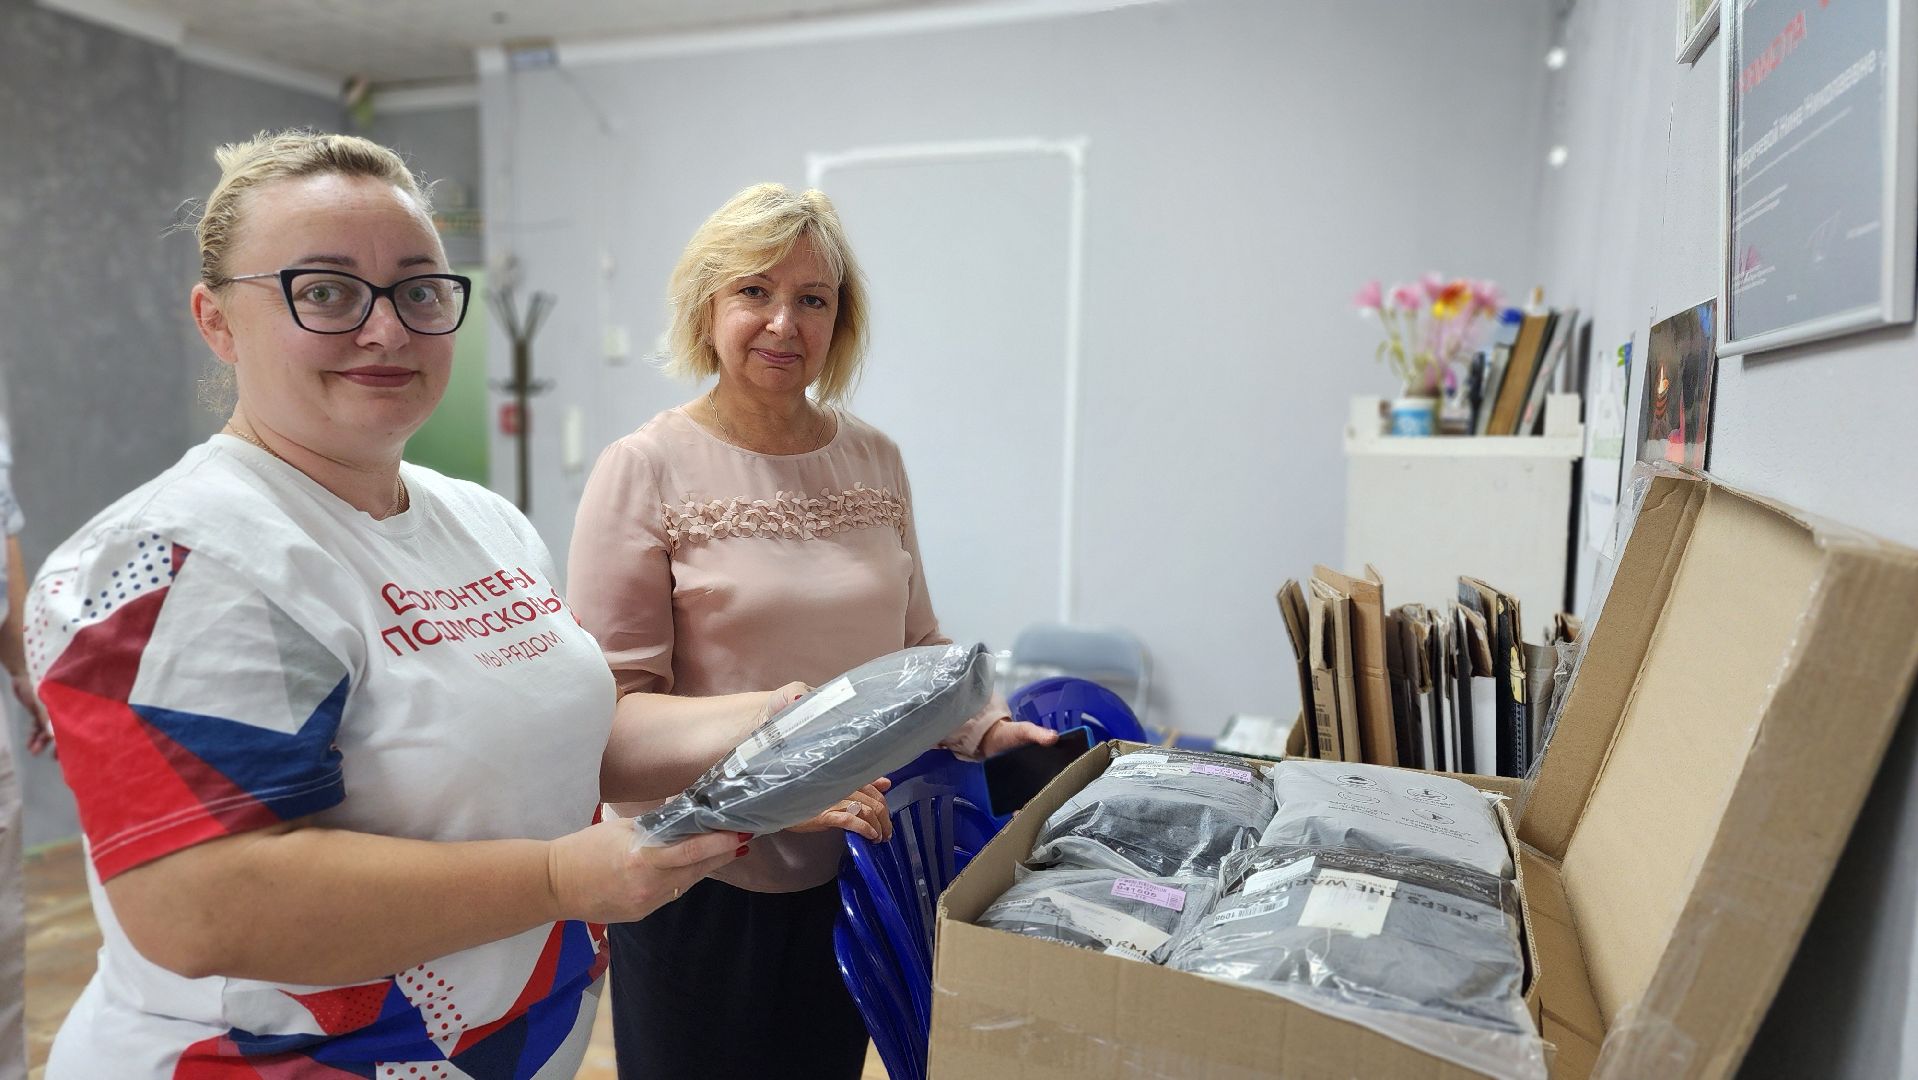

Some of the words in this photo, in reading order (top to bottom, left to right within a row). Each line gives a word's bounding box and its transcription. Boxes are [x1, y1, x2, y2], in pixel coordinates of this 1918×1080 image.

[381, 566, 538, 616] ВОЛОНТЕРЫ
[498, 629, 565, 666] РЯДОМ
[1355, 882, 1401, 900] THE
[1407, 894, 1479, 923] KEEPS
